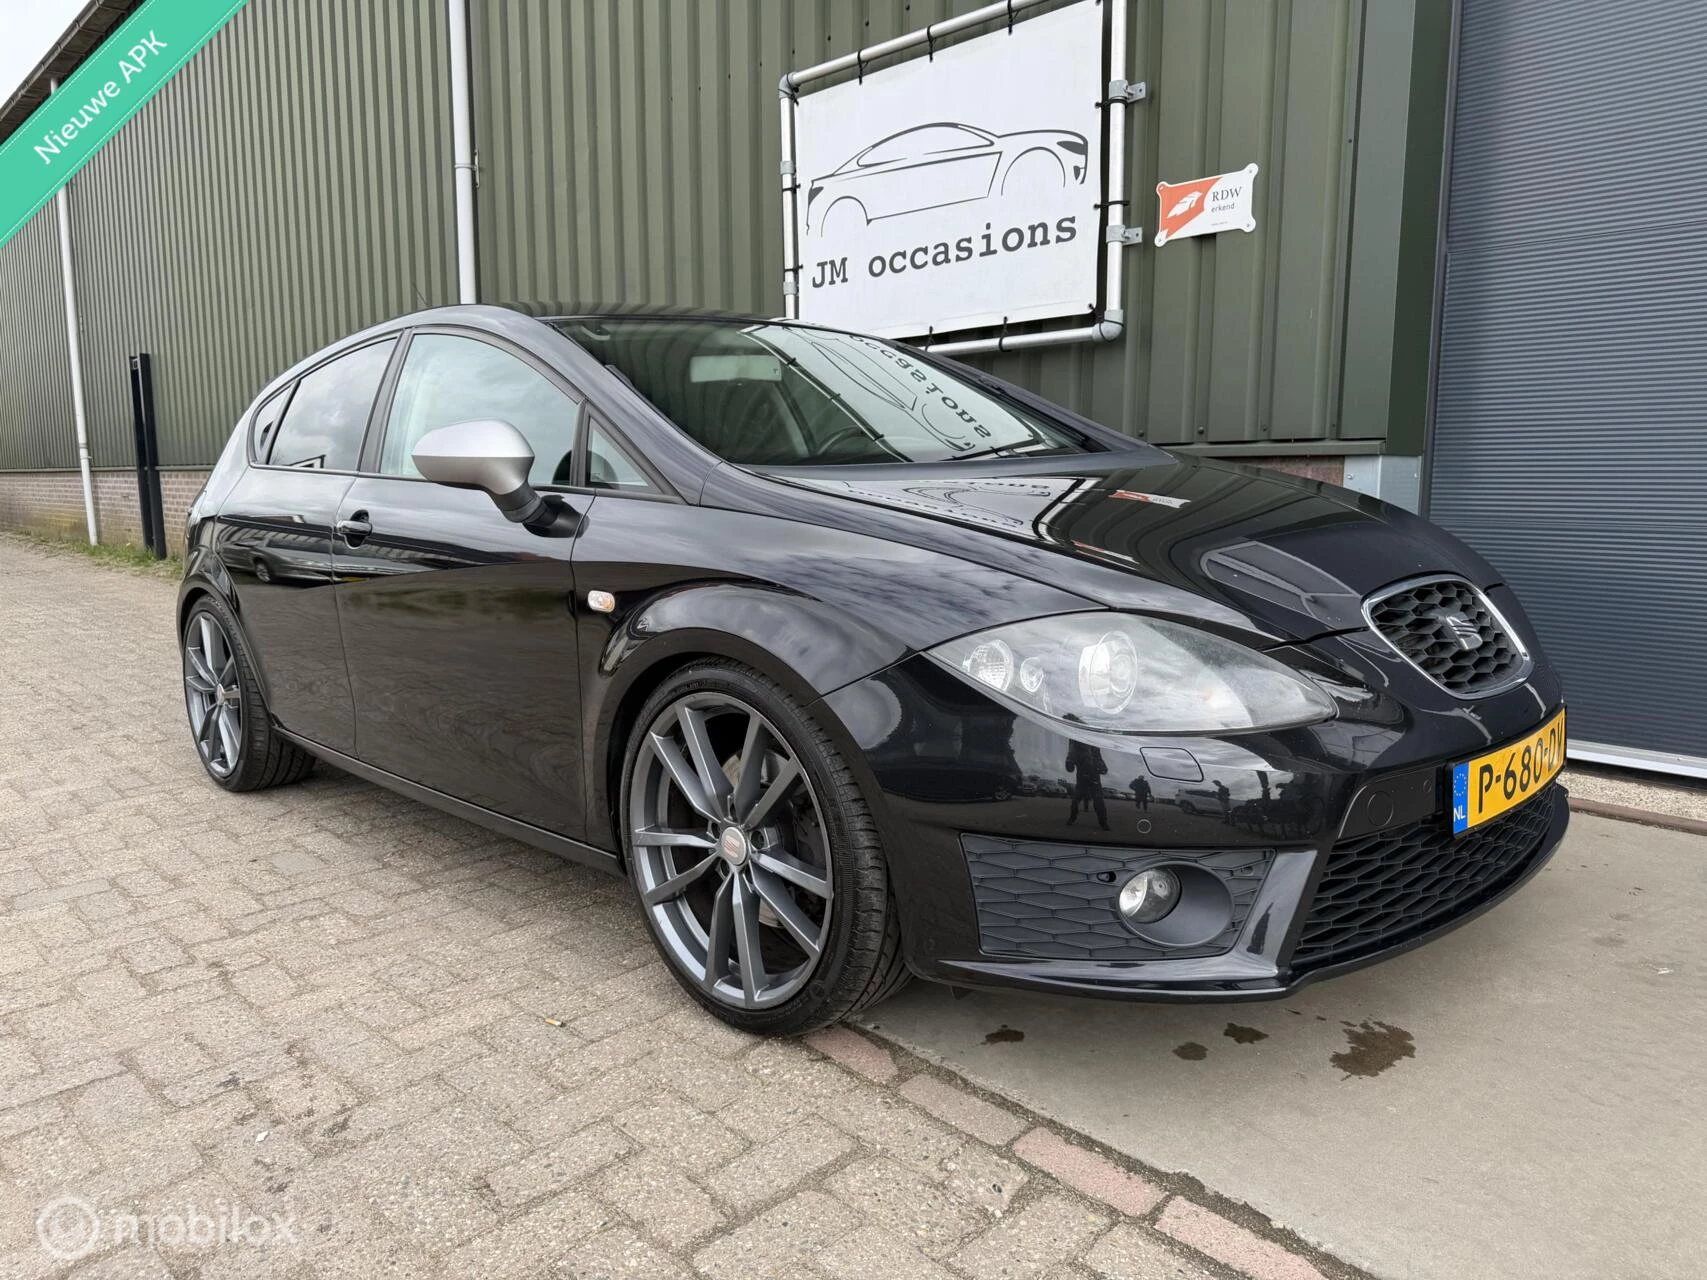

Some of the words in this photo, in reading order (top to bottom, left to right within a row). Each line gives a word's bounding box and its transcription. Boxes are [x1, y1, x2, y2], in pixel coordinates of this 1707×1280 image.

[1211, 186, 1242, 202] RDW
[1210, 202, 1235, 213] erkend
[811, 256, 849, 288] JM
[867, 215, 1077, 278] occasions
[1453, 805, 1466, 822] NL
